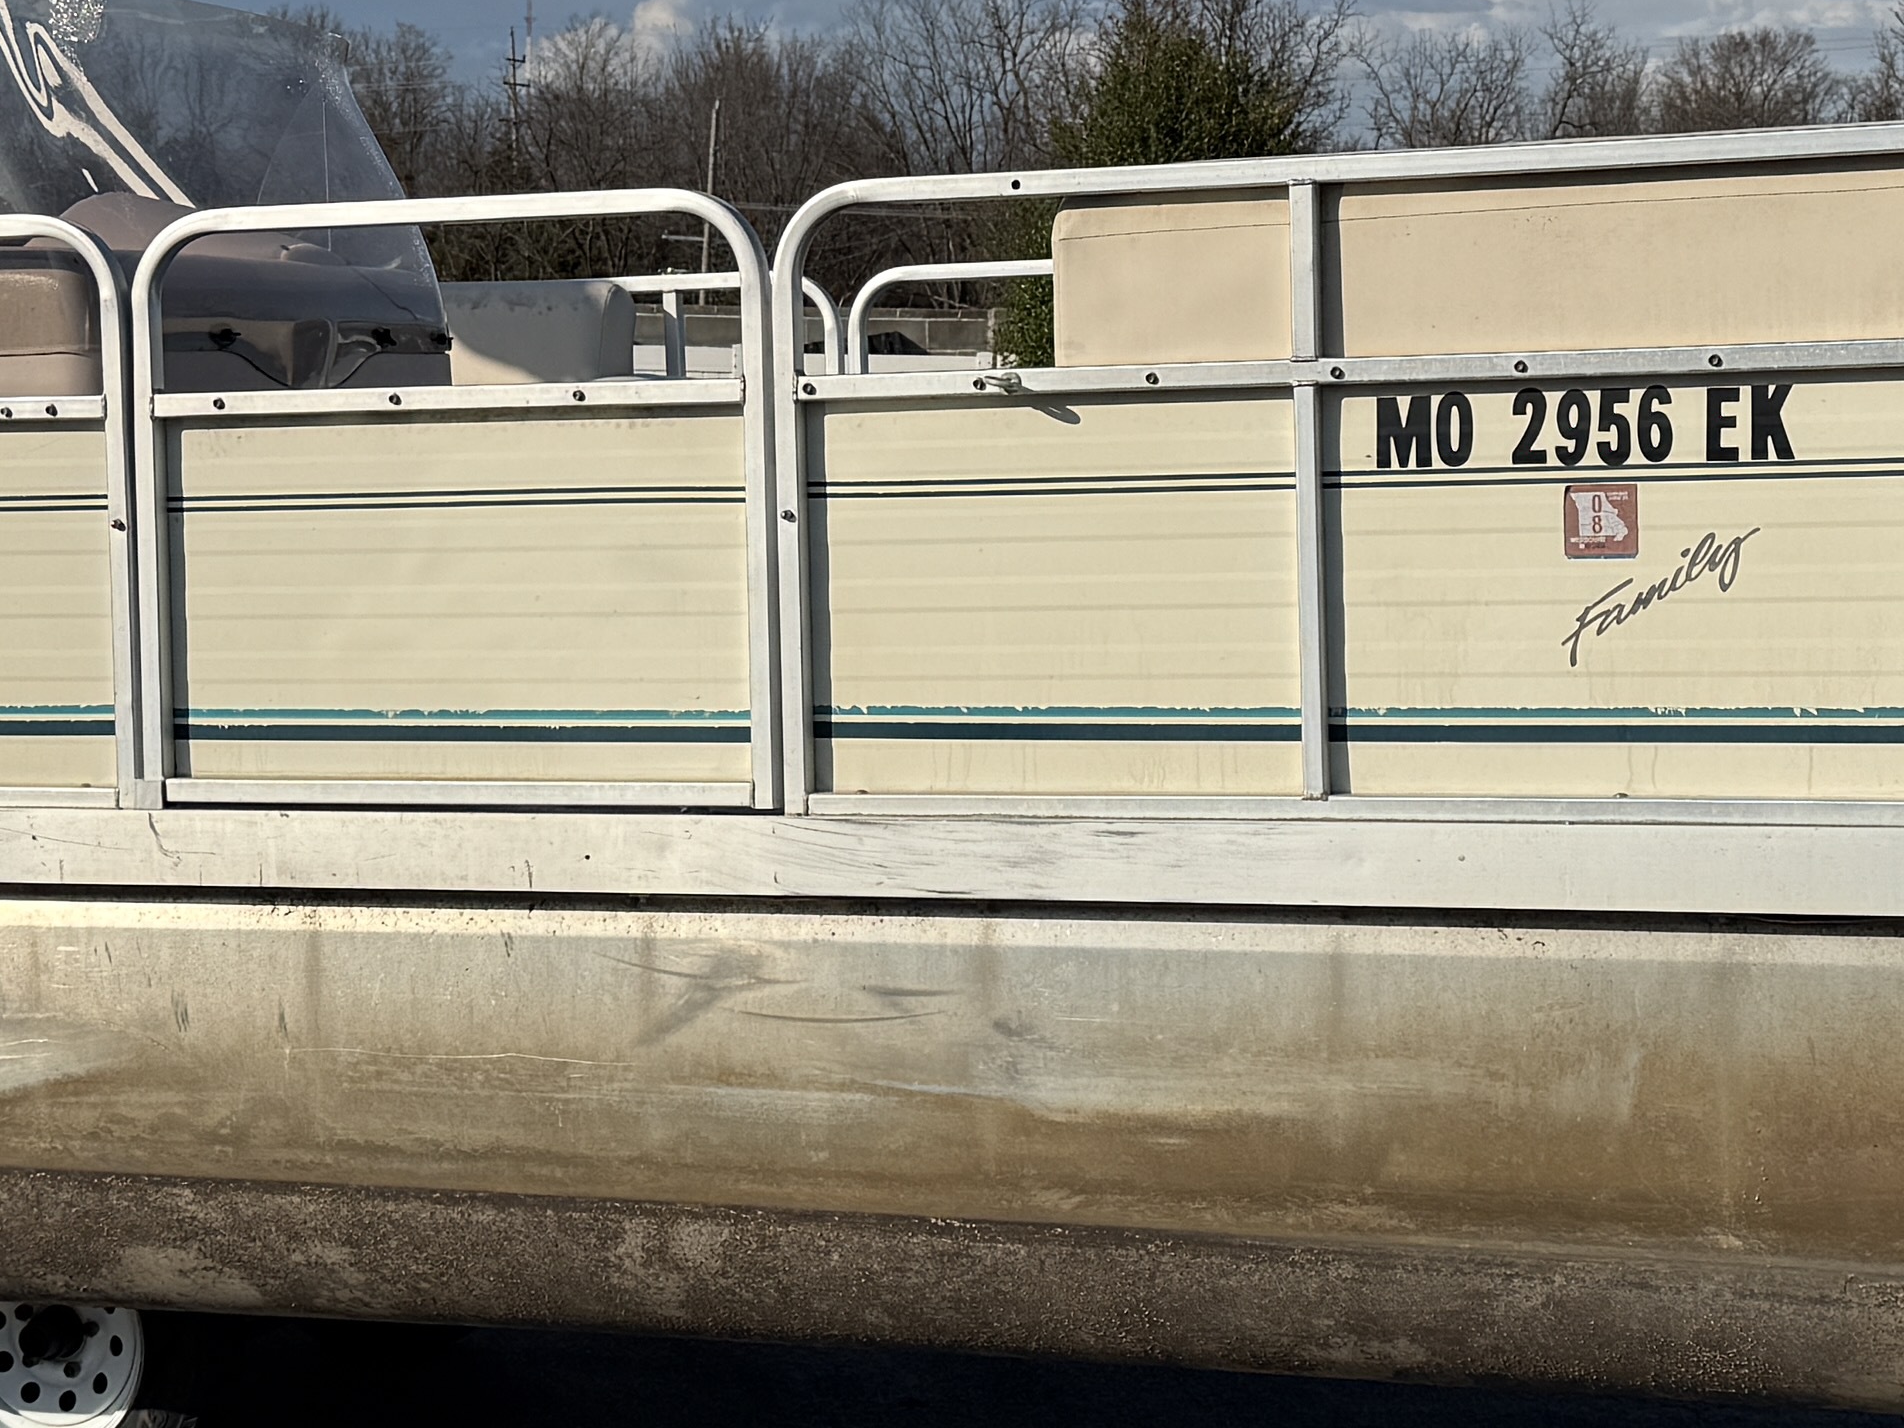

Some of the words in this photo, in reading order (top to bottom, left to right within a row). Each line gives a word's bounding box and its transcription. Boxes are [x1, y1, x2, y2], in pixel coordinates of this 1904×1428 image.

[1376, 391, 1474, 469] MO
[1511, 384, 1674, 467] 2956
[1705, 384, 1796, 462] EK
[1561, 527, 1761, 667] Family
